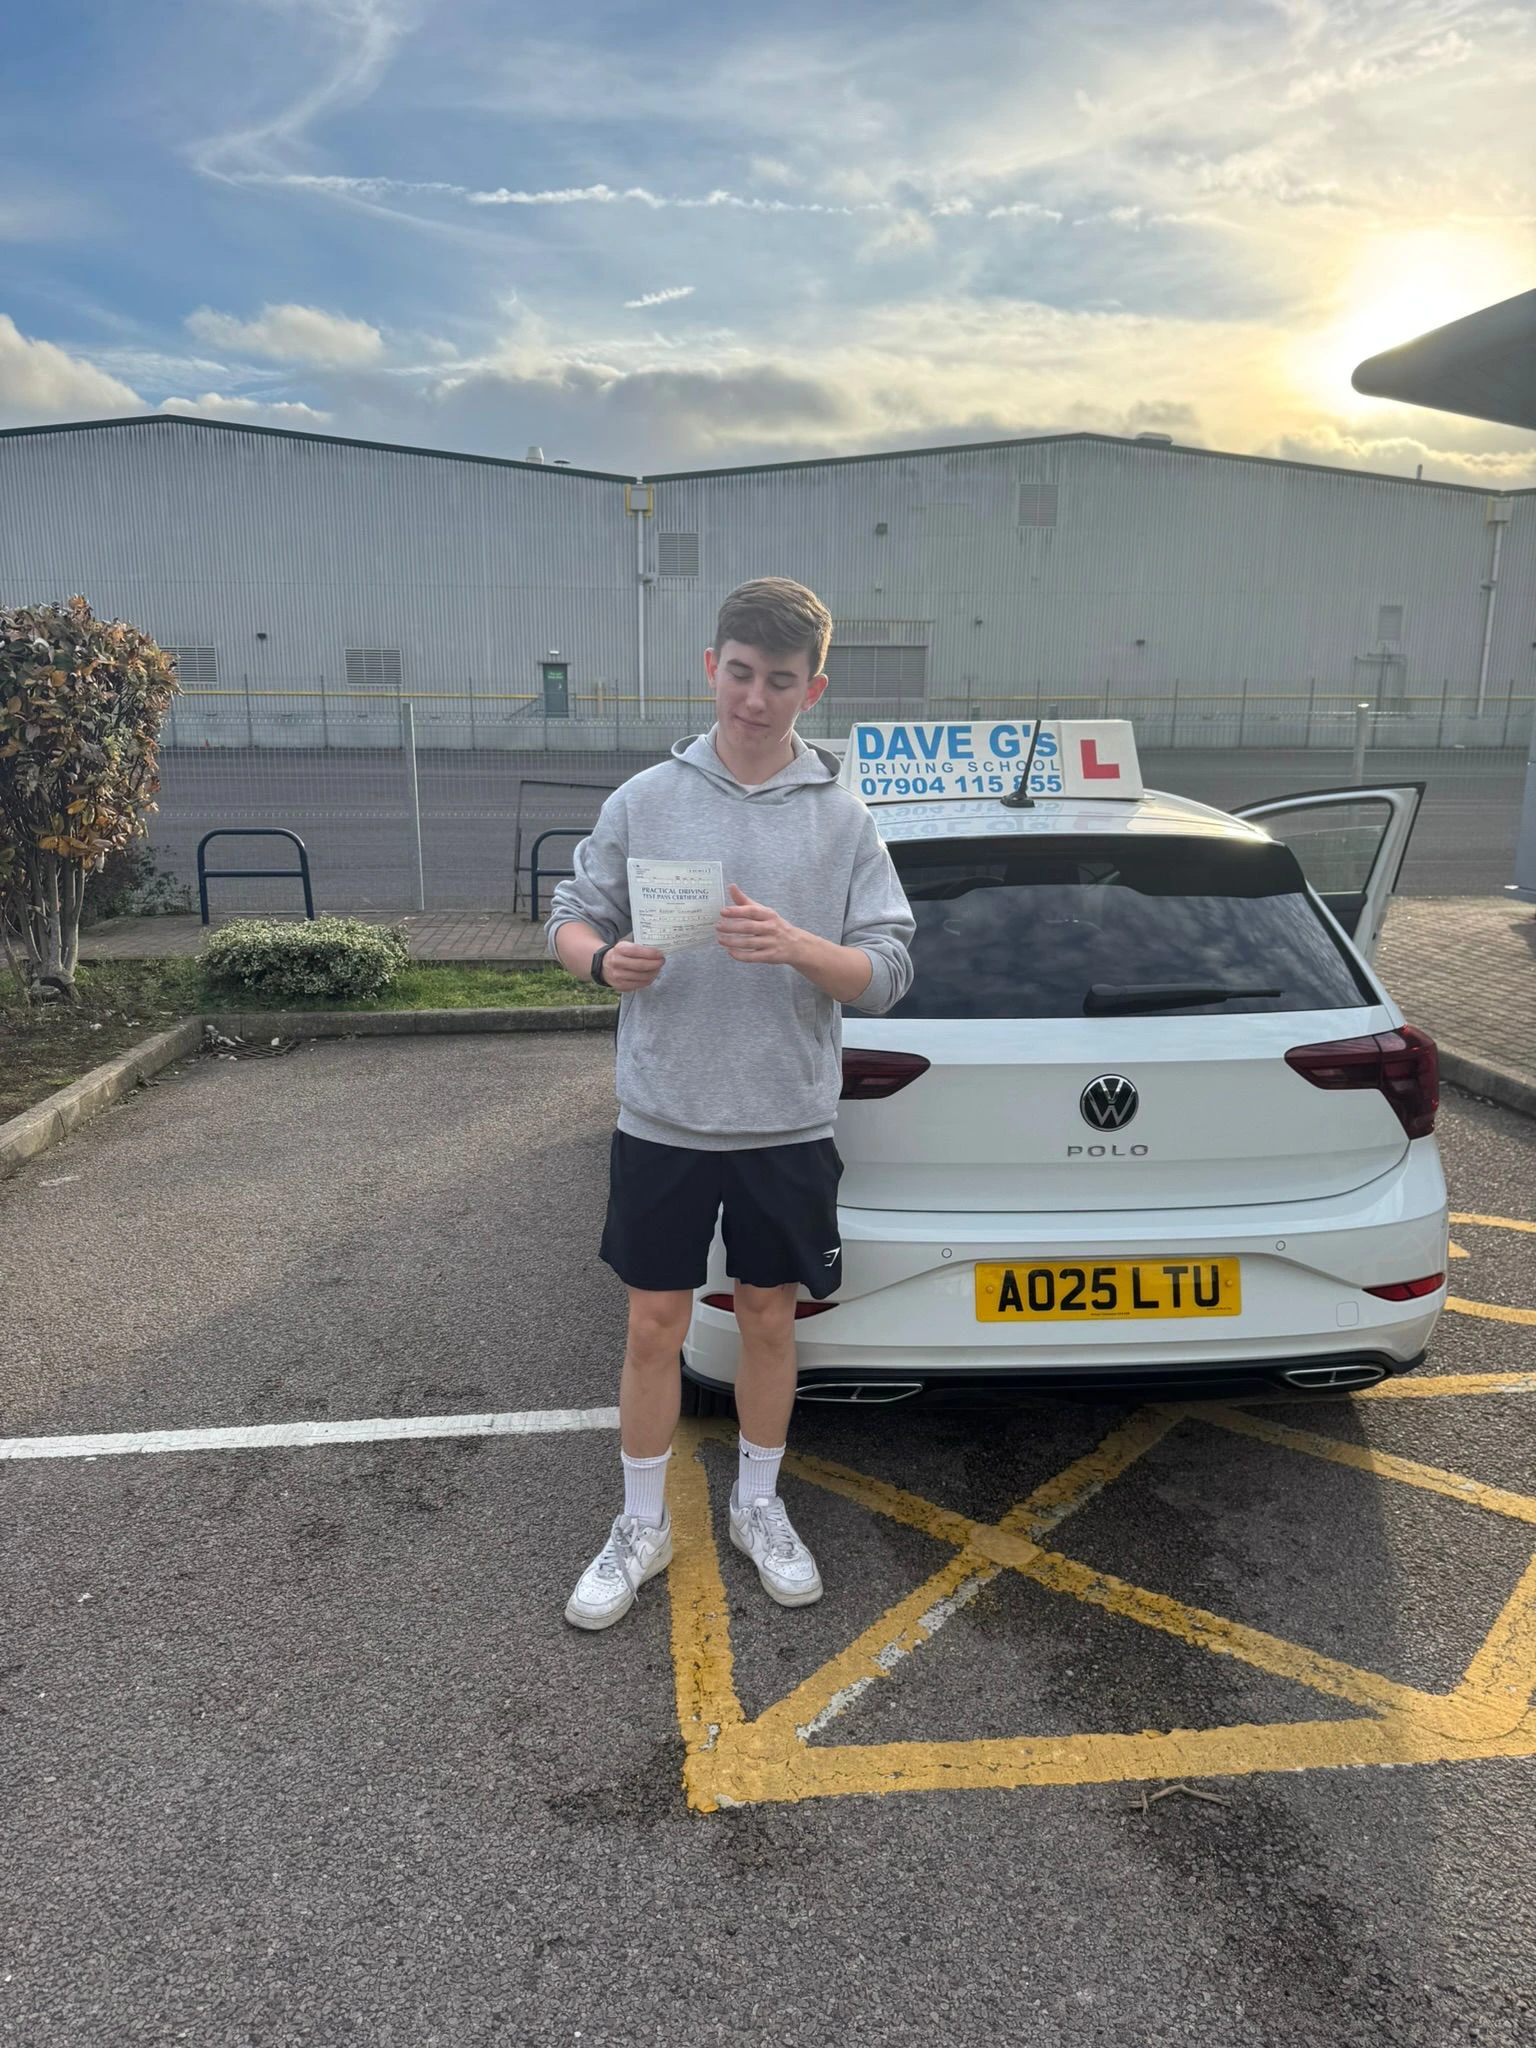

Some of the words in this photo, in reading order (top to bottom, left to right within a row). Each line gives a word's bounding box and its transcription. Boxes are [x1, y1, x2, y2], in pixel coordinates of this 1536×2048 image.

[857, 725, 974, 760] DAVE
[989, 724, 1058, 758] G's
[860, 761, 954, 774] DRIVING
[967, 759, 1060, 773] SCHOOL
[1080, 739, 1120, 779] L
[861, 776, 945, 796] 07904
[955, 775, 1004, 793] 115
[1067, 1144, 1149, 1157] POLO
[998, 1267, 1117, 1312] AO25
[1132, 1265, 1220, 1309] LTU
